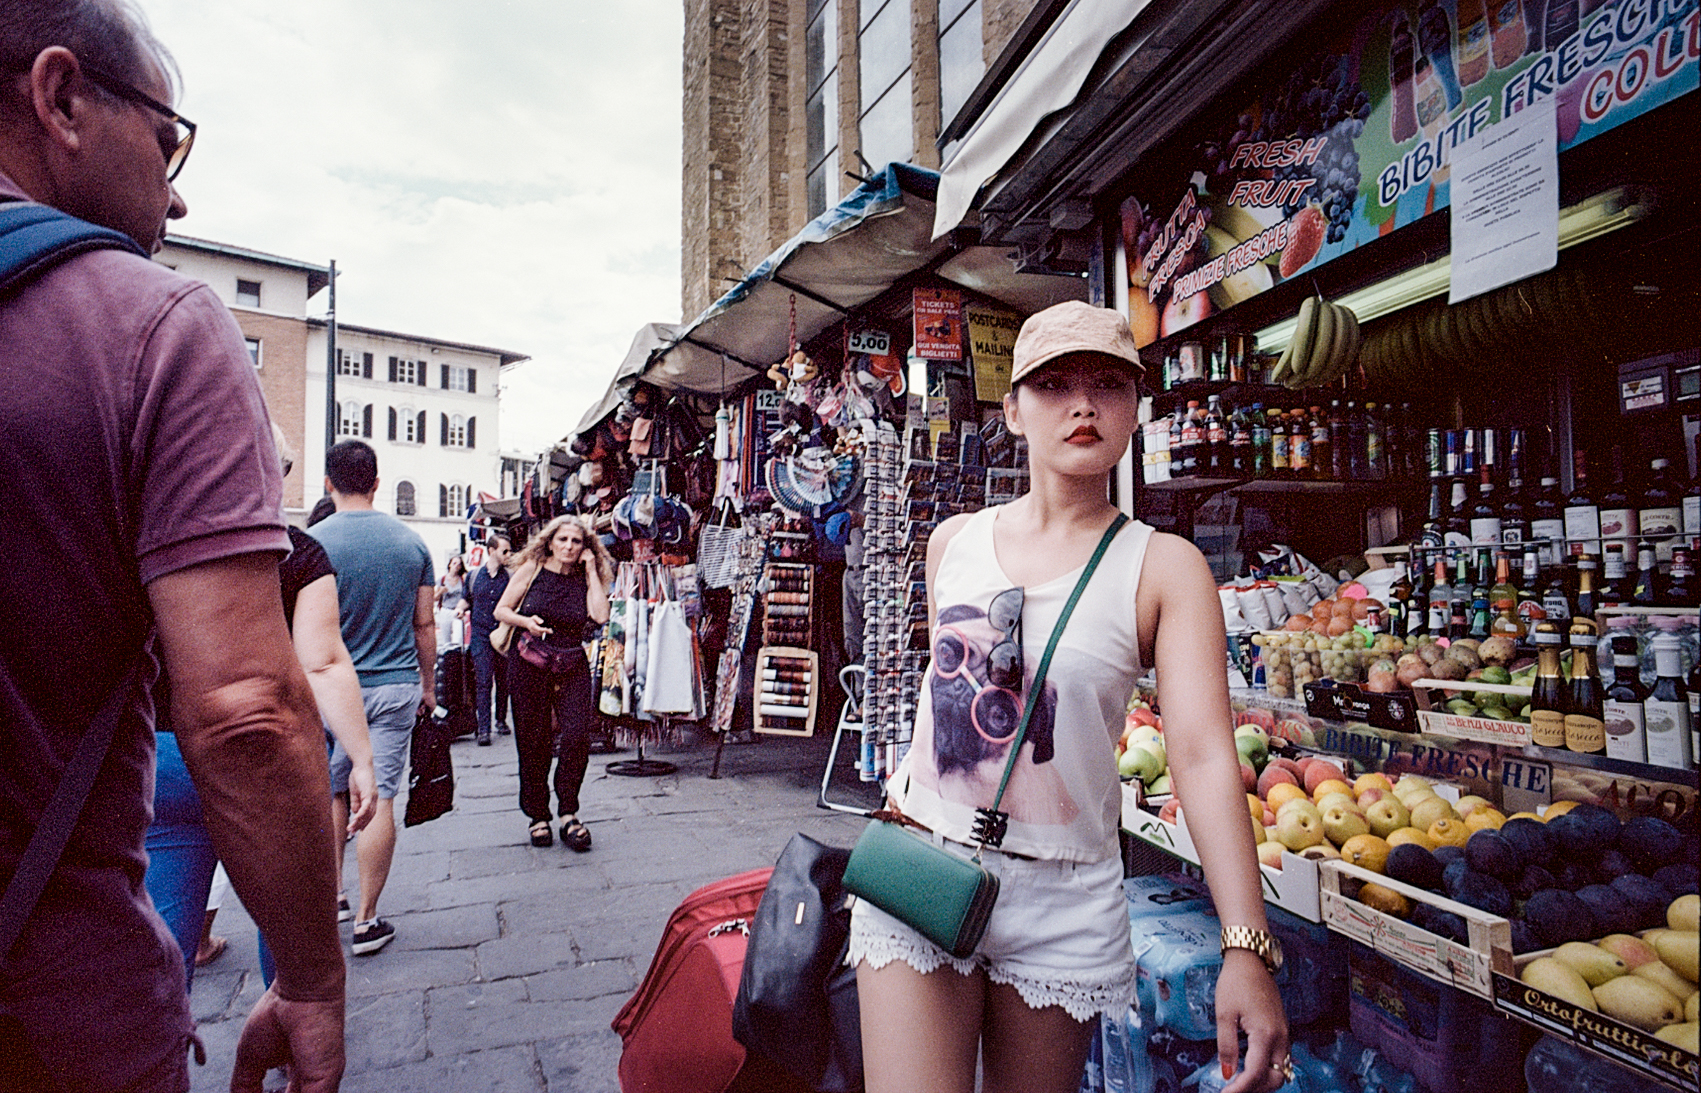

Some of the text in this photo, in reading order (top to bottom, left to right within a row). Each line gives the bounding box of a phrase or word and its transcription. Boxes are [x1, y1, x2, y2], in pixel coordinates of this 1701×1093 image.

[1229, 136, 1328, 168] FRESH
[1379, 104, 1486, 201] BIBITE
[1227, 178, 1317, 207] FRUIT
[1142, 187, 1196, 281] FRUTTA
[1148, 209, 1206, 304] FRESCA
[1172, 220, 1288, 304] PRIMIZIE FRESCHE
[921, 300, 955, 309] TICKETS
[851, 333, 888, 351] 5,00
[920, 349, 957, 358] BIGLIETTI
[931, 342, 960, 350] VENDITA
[1483, 720, 1526, 736] GLAUCO
[1324, 728, 1401, 764] BIBITE
